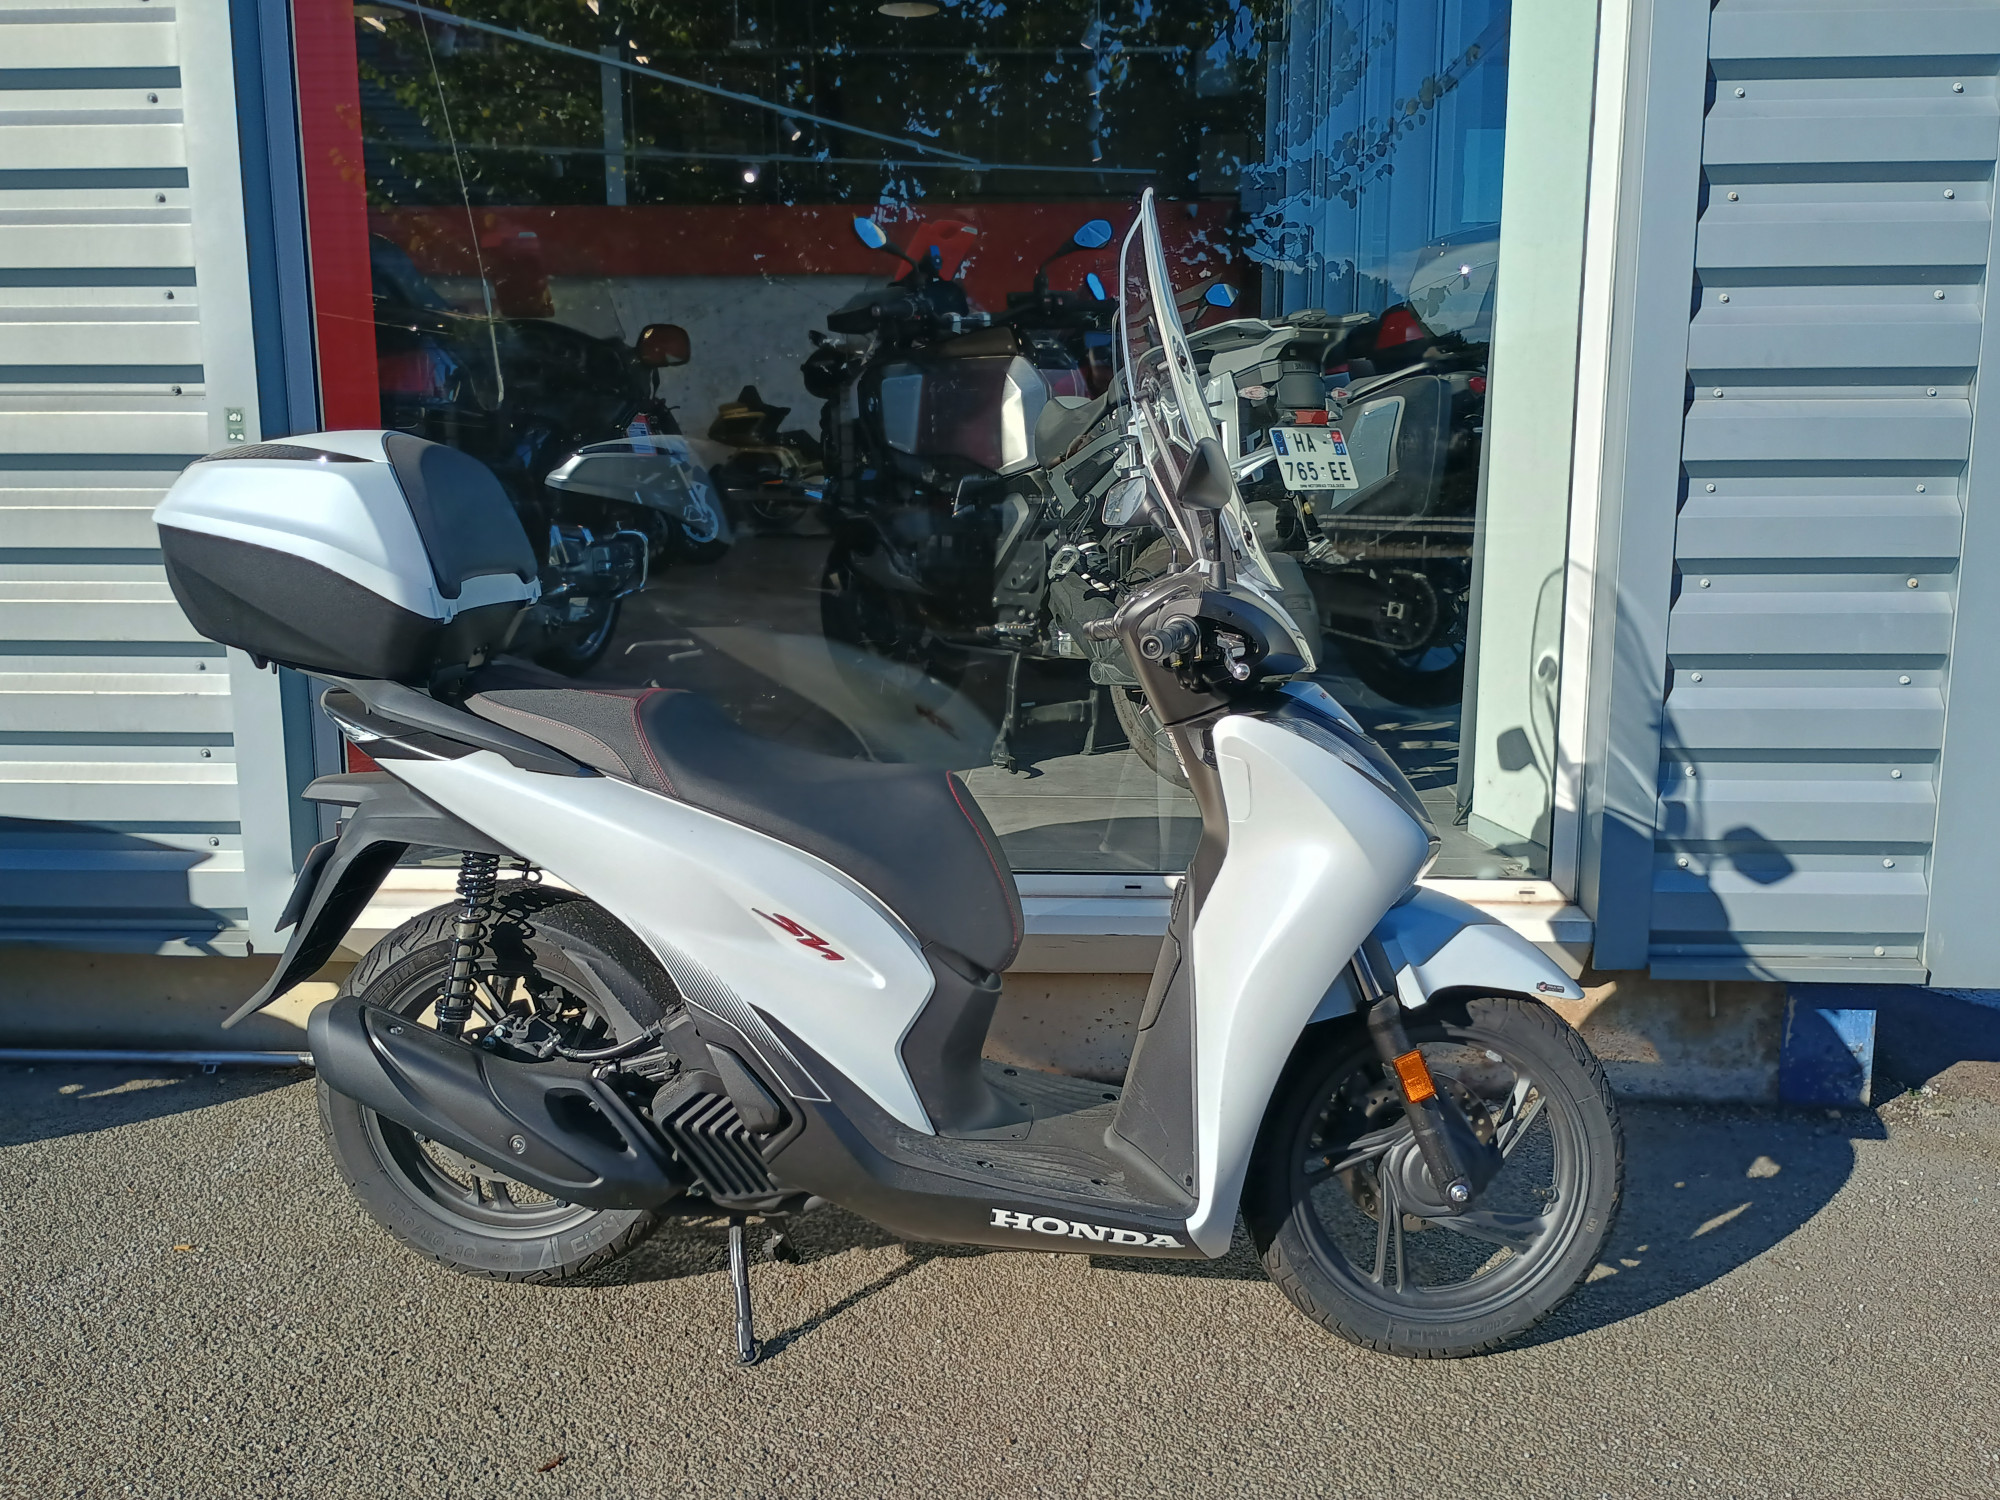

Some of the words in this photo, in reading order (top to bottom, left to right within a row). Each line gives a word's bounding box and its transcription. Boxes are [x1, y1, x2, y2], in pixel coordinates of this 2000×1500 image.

[1293, 433, 1317, 452] HA
[1284, 461, 1351, 481] 765-EE
[990, 1208, 1186, 1248] HONDA
